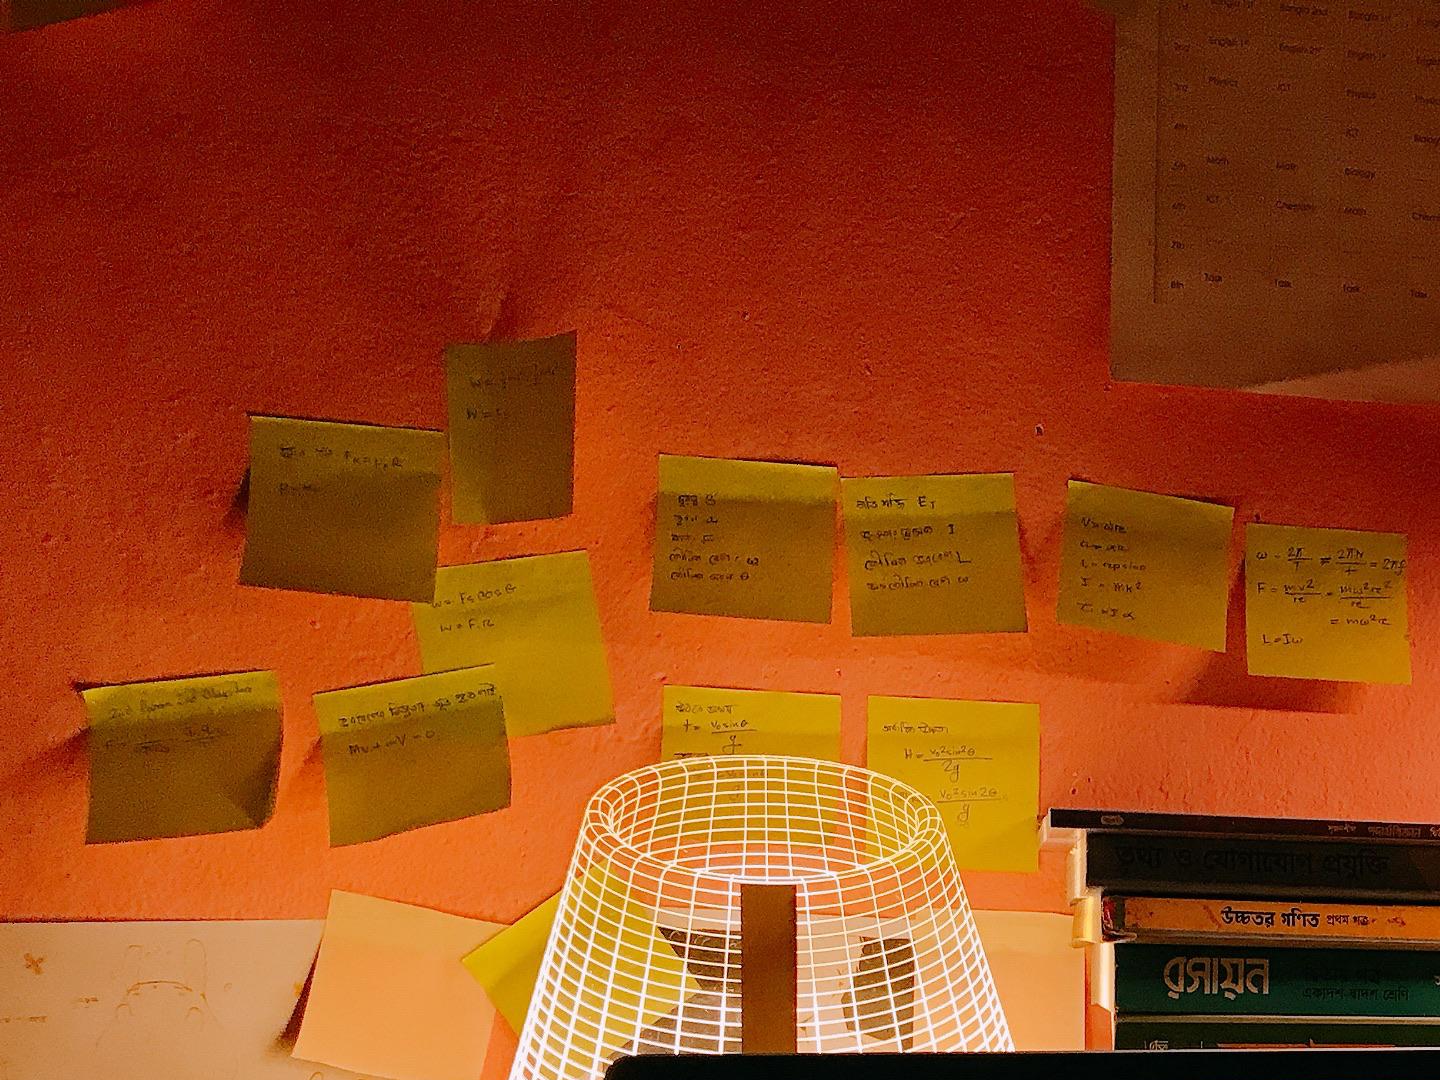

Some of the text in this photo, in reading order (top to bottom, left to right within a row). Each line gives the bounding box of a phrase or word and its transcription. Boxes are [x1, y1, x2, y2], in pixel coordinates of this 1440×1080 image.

[1220, 907, 1275, 928] উচ্চতর
[1281, 907, 1320, 928] গণিত
[1326, 914, 1349, 926] প্রথম
[1163, 955, 1269, 1001] রসায়ন
